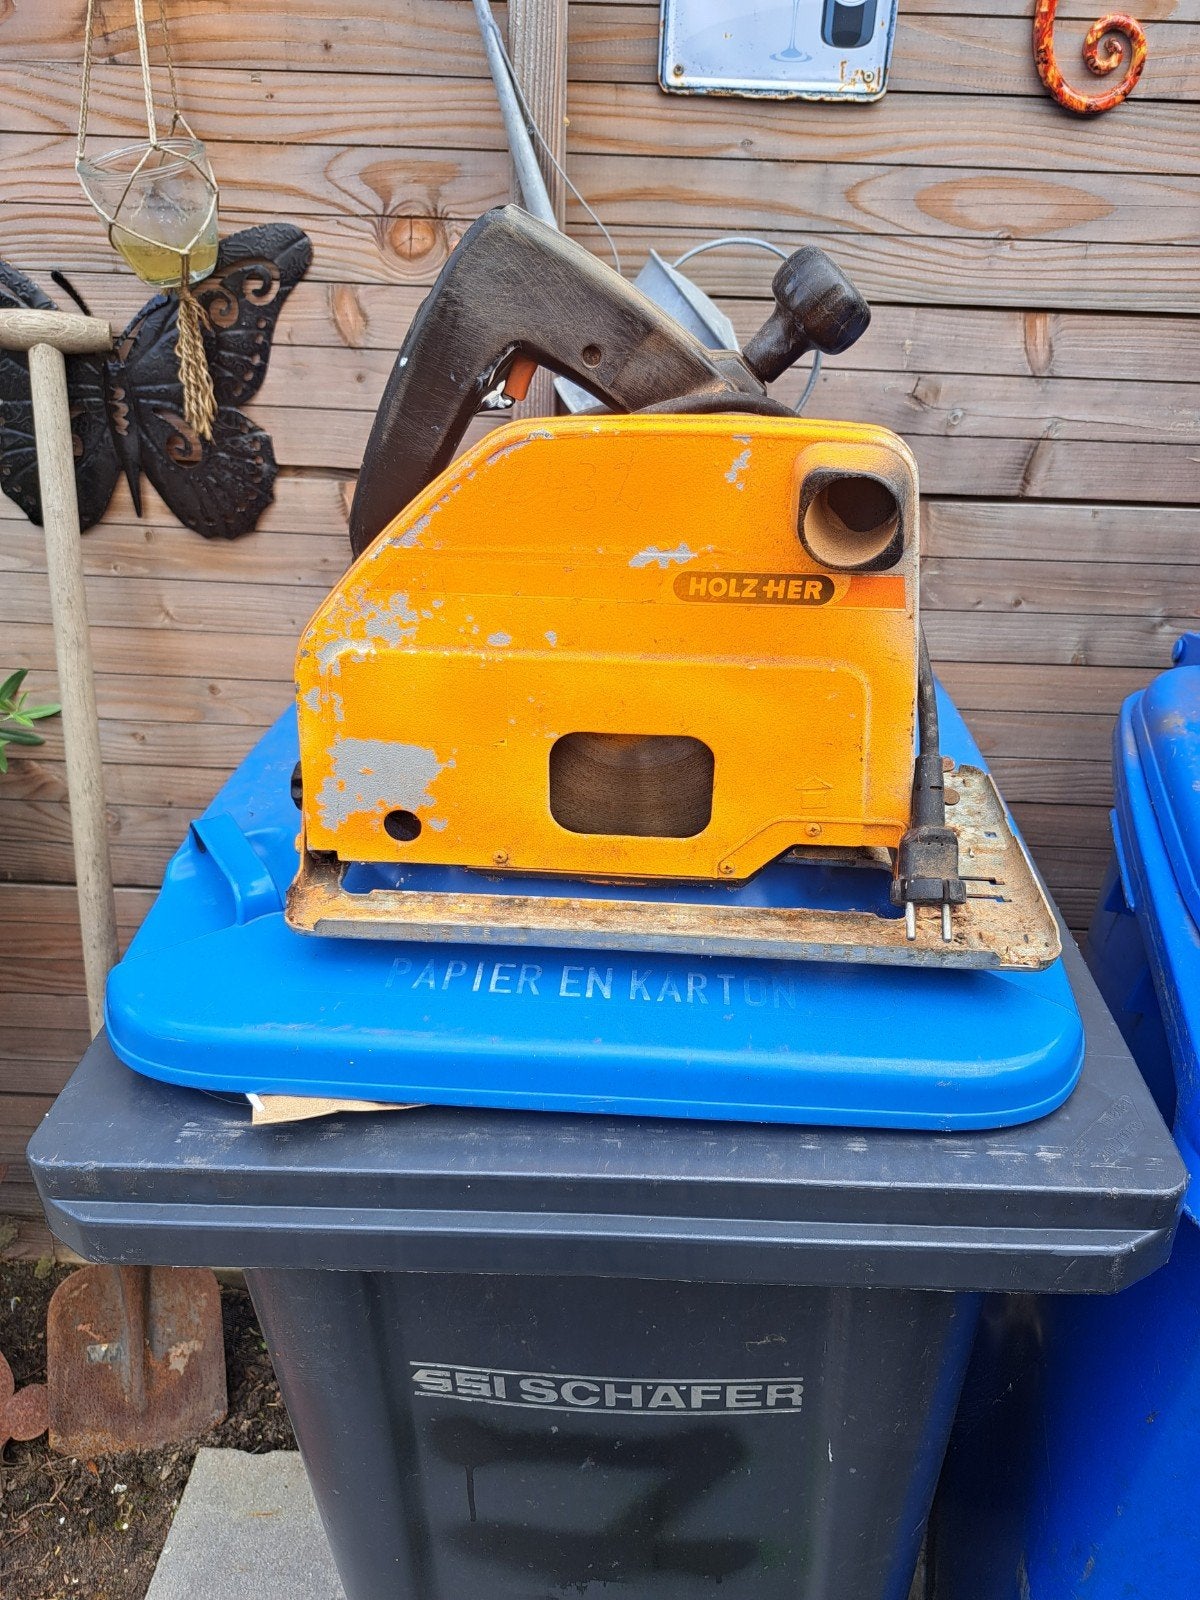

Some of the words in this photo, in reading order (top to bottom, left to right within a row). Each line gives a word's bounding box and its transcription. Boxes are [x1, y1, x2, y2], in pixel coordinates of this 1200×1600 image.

[384, 957, 542, 996] PAPIER
[559, 965, 613, 999] EN
[629, 969, 797, 1008] KARTON
[411, 1368, 507, 1399] SSI
[518, 1378, 804, 1409] SCHÄFER
